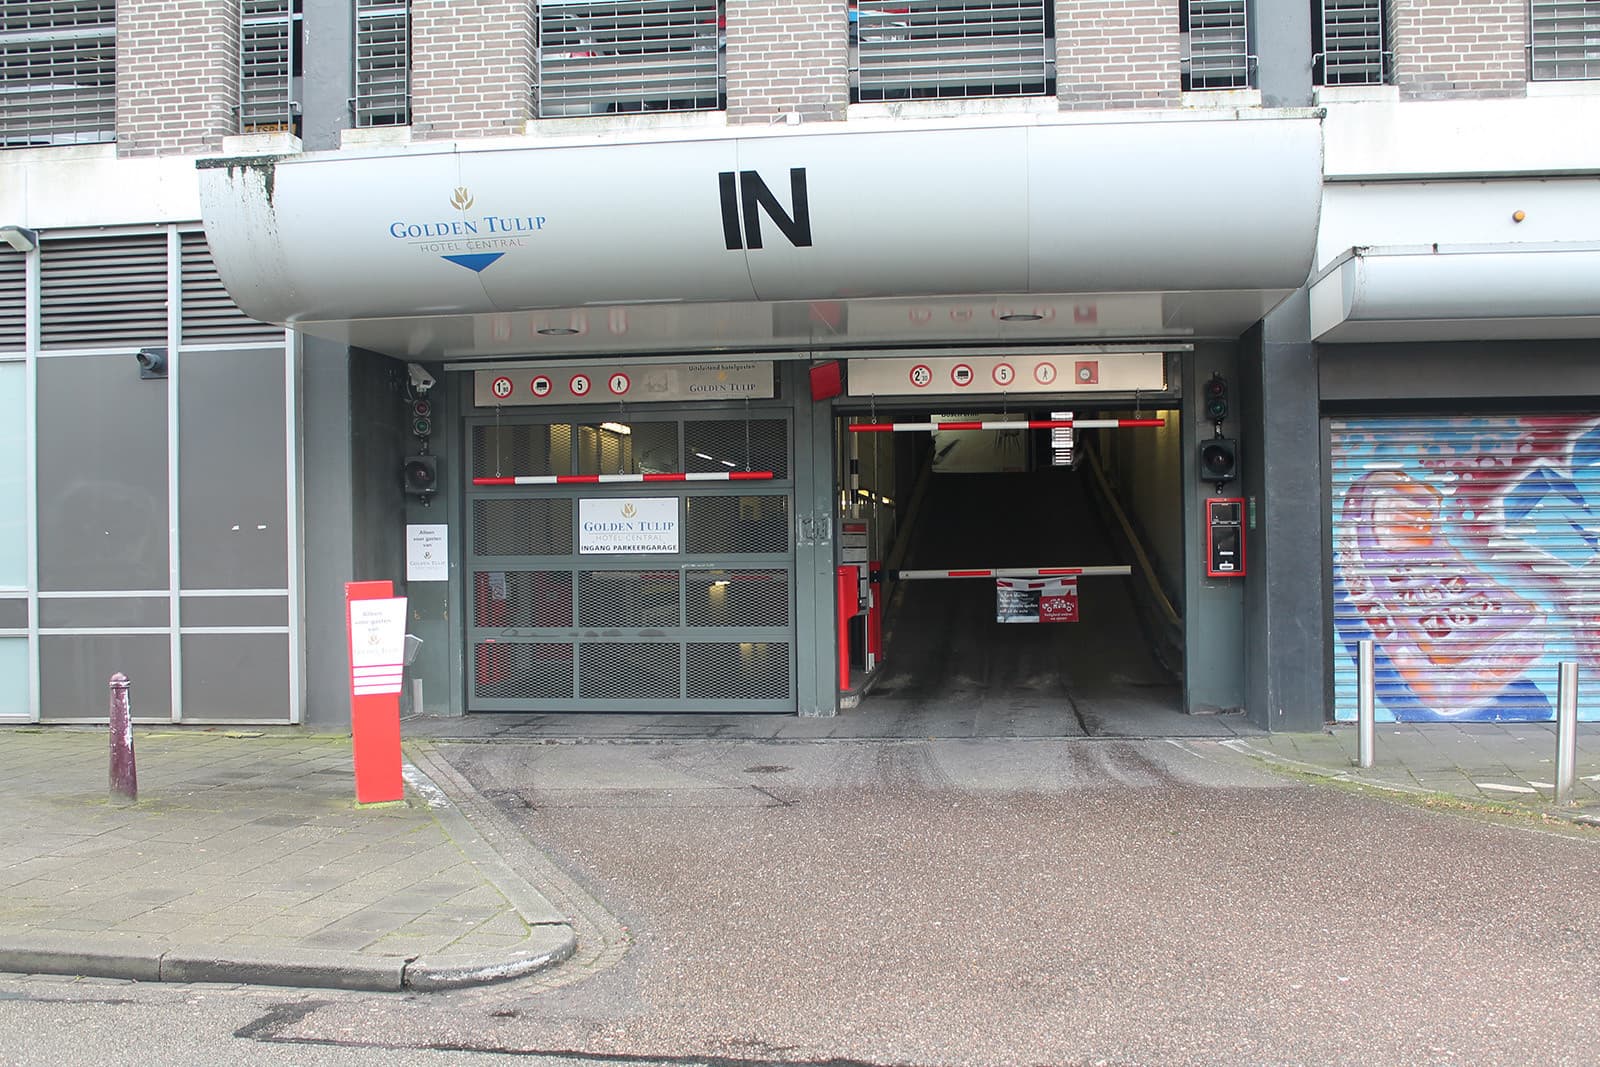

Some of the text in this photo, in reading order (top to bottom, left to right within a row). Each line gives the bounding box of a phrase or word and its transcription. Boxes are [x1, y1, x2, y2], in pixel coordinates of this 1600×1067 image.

[718, 167, 812, 250] IN
[420, 238, 524, 253] HOTEL CENTRAL
[1001, 369, 1007, 379] 5
[577, 380, 583, 390] 5
[584, 521, 674, 532] GOLDEN TULIP
